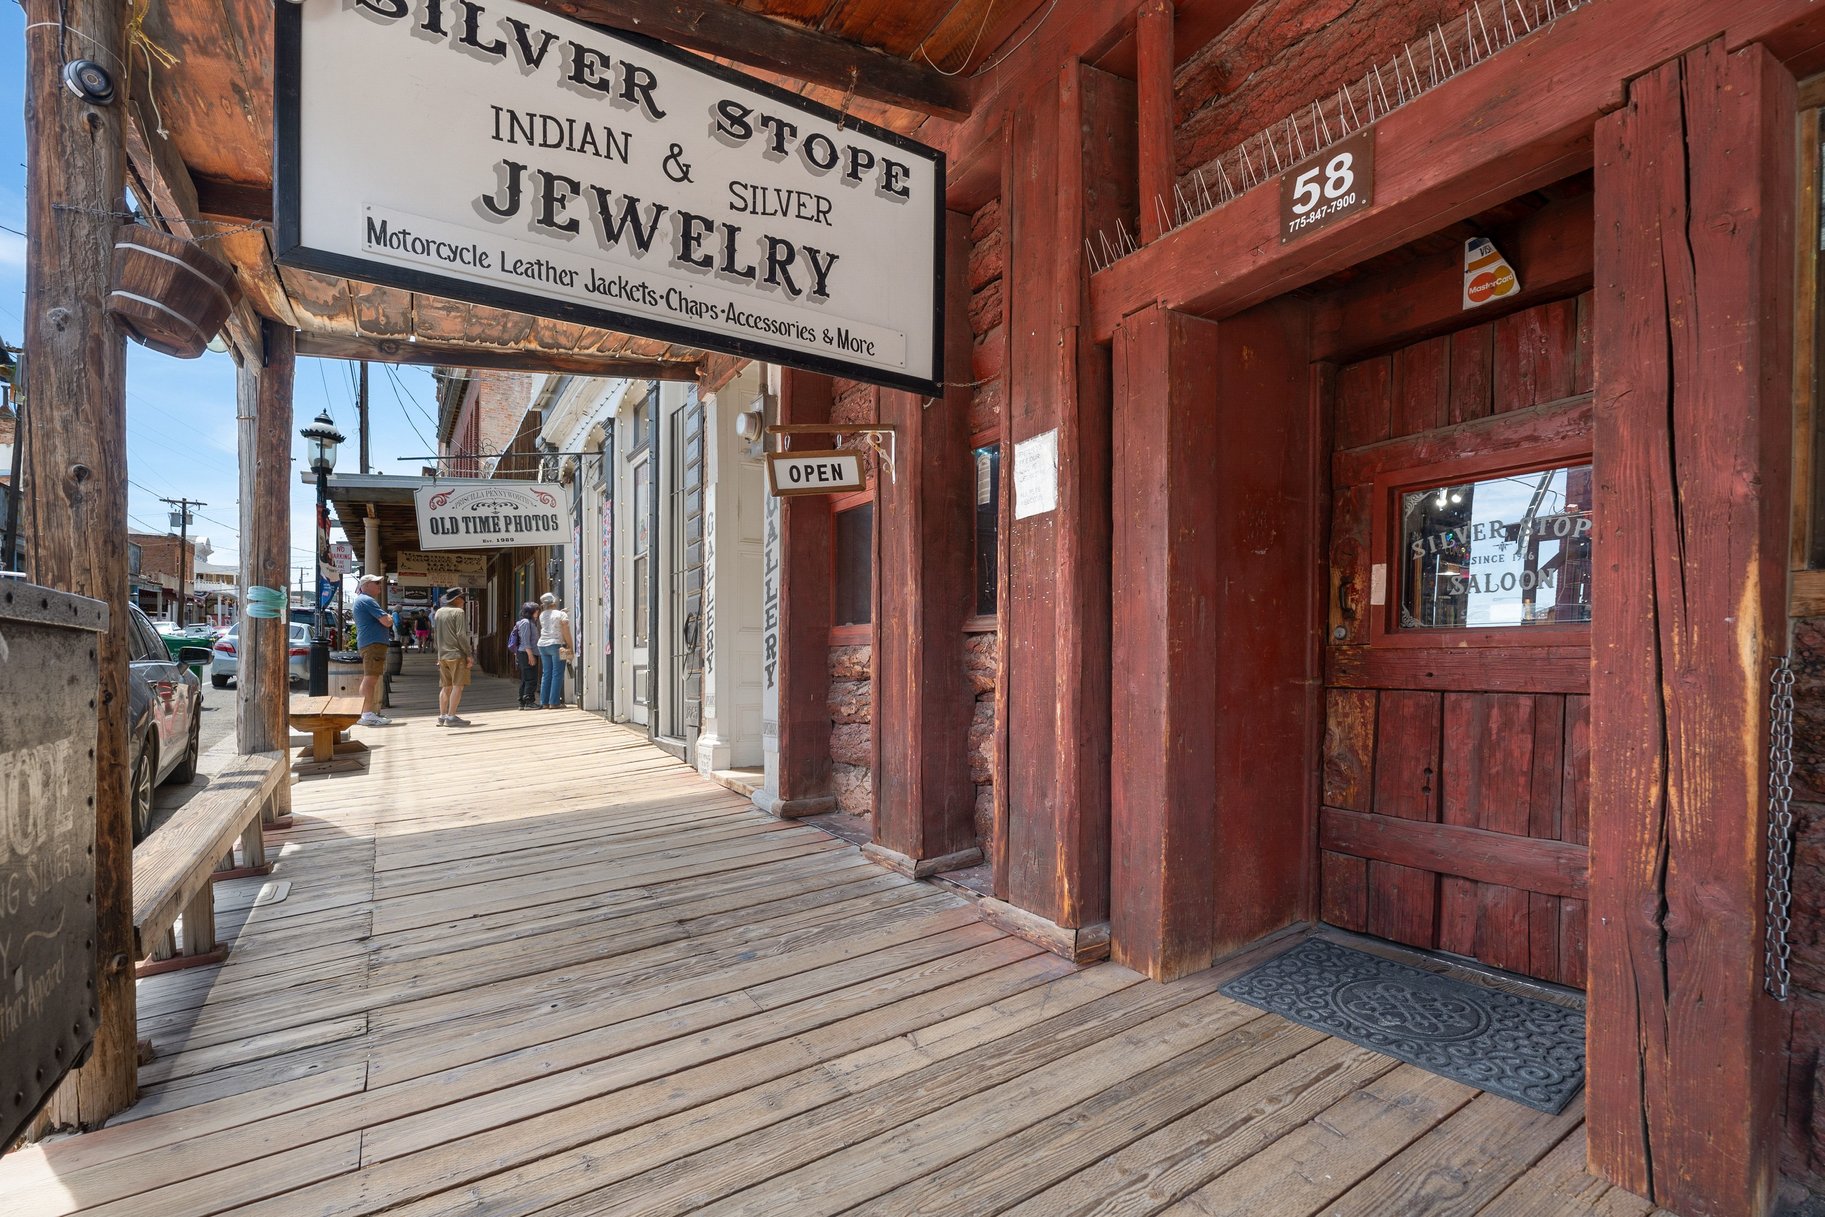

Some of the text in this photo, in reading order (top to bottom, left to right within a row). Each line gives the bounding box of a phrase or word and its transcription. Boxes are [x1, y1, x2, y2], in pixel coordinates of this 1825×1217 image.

[490, 105, 834, 226] INDIAN & SILVER
[709, 98, 911, 201] STOPE
[1288, 192, 1356, 234] 775-847-7900
[1291, 152, 1354, 215] 58
[476, 158, 840, 302] JEWELRY
[366, 215, 491, 269] Motorcycle
[500, 250, 580, 288] Leather
[822, 328, 834, 345] &
[837, 327, 876, 357] More
[1469, 274, 1514, 295] MasterCard
[789, 463, 844, 483] OPEN
[430, 513, 560, 536] OLD TIME PHOTOS
[1411, 519, 1509, 560] SILVER
[765, 490, 779, 690] GALLERY
[1449, 568, 1555, 596] SALOON
[1471, 554, 1505, 565] SINCE
[706, 512, 715, 673] GALLERY
[27, 844, 72, 907] SILVER
[28, 944, 65, 1021] Apparel
